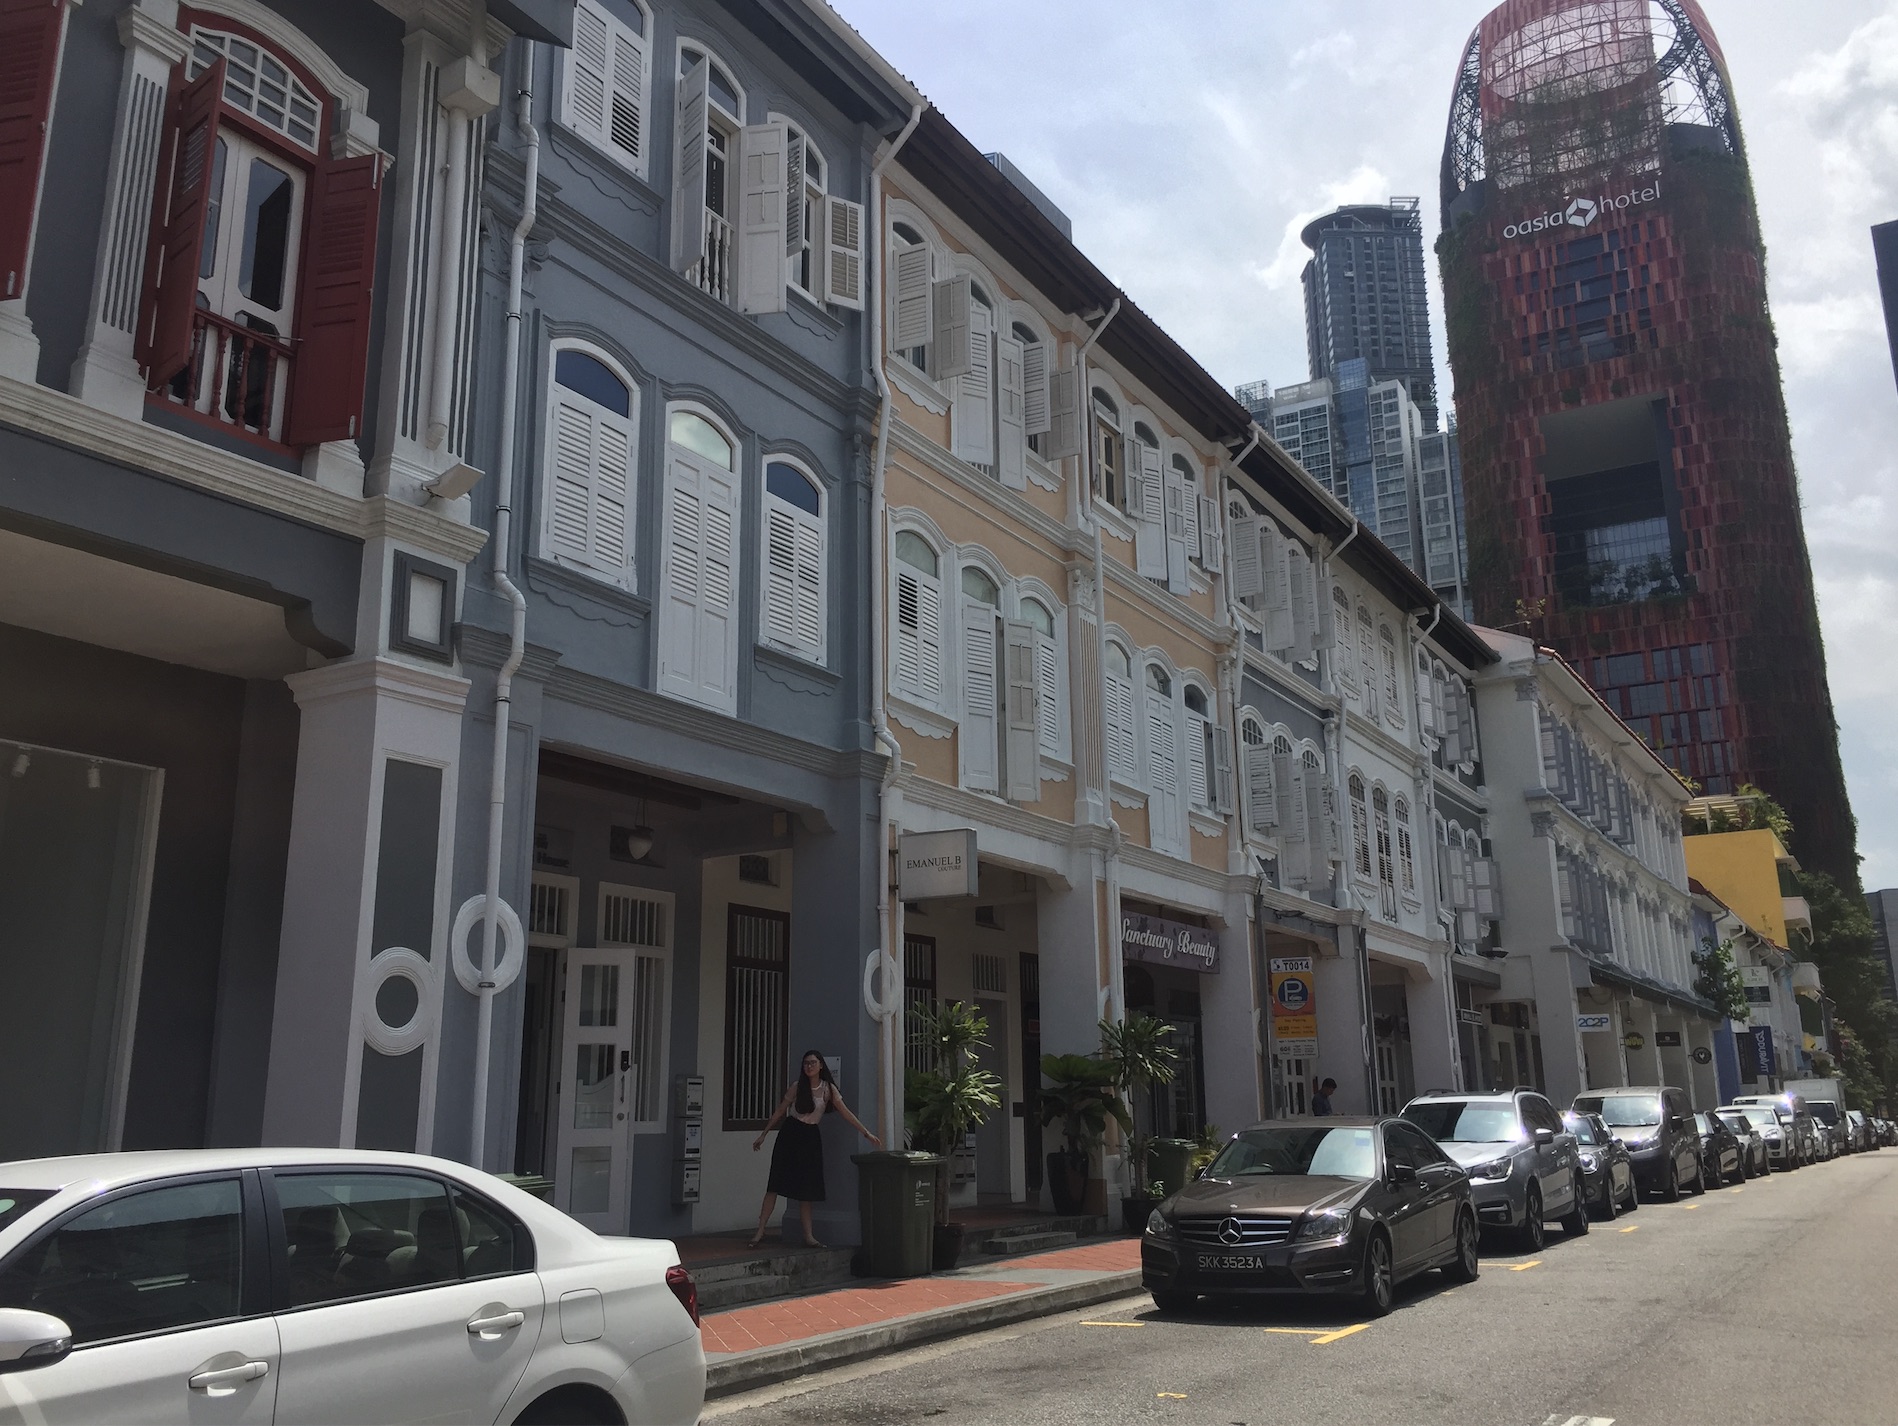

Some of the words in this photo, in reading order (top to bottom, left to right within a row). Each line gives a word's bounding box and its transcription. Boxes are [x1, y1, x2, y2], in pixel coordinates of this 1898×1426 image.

[1503, 210, 1564, 239] oasia
[1599, 180, 1661, 214] hotel
[906, 856, 953, 869] EMANUEL
[955, 855, 962, 865] B
[1121, 918, 1174, 959] Sanctuary
[1177, 930, 1216, 967] Beauty
[1283, 961, 1310, 971] T0014
[1578, 1017, 1608, 1027] 2C2P
[1757, 1041, 1770, 1073] DURAVIT
